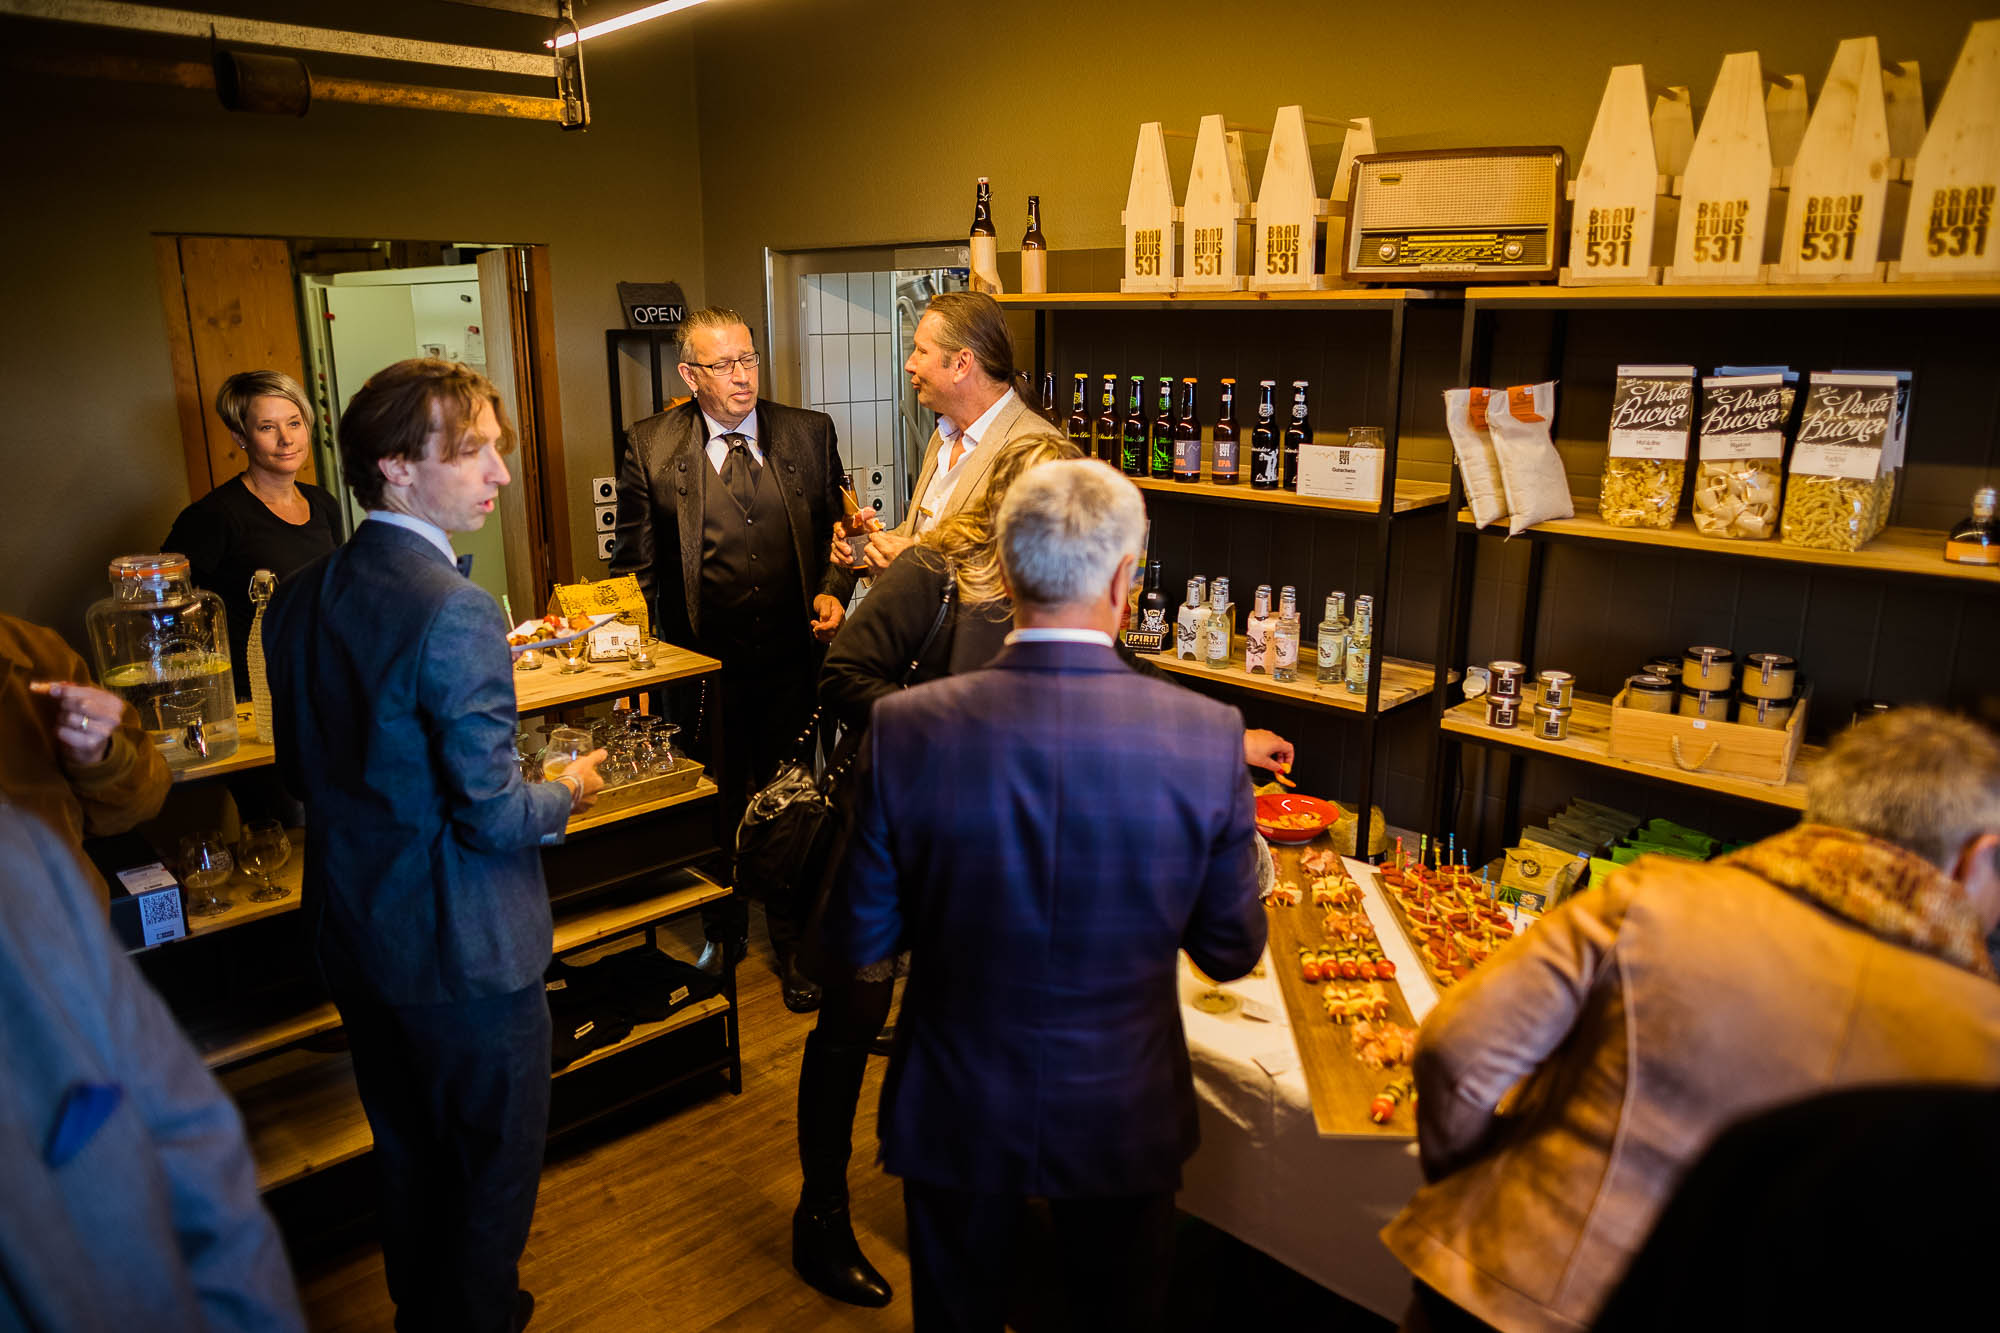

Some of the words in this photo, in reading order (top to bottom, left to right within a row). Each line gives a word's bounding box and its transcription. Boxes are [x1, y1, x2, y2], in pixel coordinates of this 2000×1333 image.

[1808, 195, 1863, 214] BRAU
[1934, 186, 1995, 208] BRAU
[1589, 207, 1635, 225] BRAU
[1698, 200, 1748, 218] BRAU
[1931, 206, 1990, 228] HUUS
[1268, 225, 1300, 239] BRAU
[1697, 218, 1744, 235] HUUS
[1806, 214, 1858, 232] HUUS
[1136, 230, 1161, 243] BRAU
[1195, 228, 1222, 241] BRAU
[1588, 225, 1632, 241] HUUS
[1928, 226, 1987, 256] 531
[1136, 243, 1160, 256] HUUS
[1195, 242, 1221, 255] HUUS
[1268, 239, 1298, 253] HUUS
[1586, 241, 1631, 267] 531
[1695, 236, 1742, 262] 531
[1801, 232, 1856, 261] 531
[1135, 256, 1160, 275] 531
[1195, 255, 1221, 275] 531
[1267, 253, 1298, 274] 531
[634, 307, 682, 325] OPEN
[1630, 381, 1692, 406] Pasta
[1717, 389, 1783, 412] Pasta
[1613, 396, 1689, 430] Buona
[1822, 390, 1898, 418] Pasta
[1701, 404, 1783, 434] Buona
[1797, 406, 1888, 444] Buona
[1217, 459, 1232, 468] IPA
[1128, 634, 1160, 643] SPIRIT
